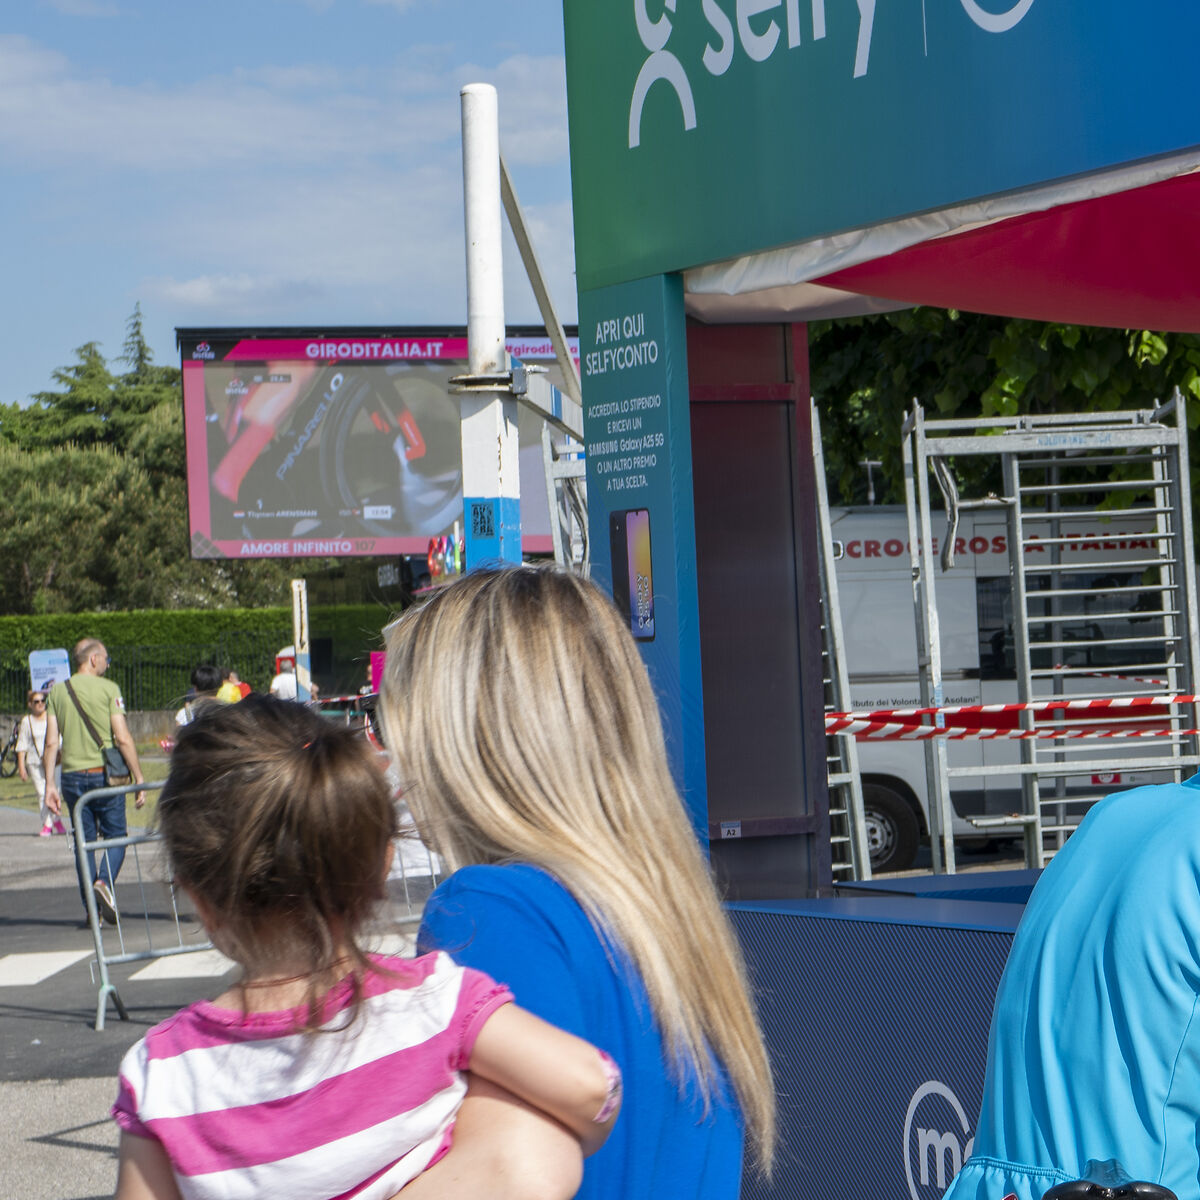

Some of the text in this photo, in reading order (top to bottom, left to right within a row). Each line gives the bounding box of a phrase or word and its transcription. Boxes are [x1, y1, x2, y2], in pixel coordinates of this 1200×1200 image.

[595, 313, 645, 345] APRI QUI
[306, 342, 443, 358] GIRODITALIA.IT
[586, 340, 658, 376] SELFYCONTO
[588, 394, 661, 419] ACCREDITA LO STIPENDIO
[607, 417, 642, 434] E RICEVI UN
[588, 432, 664, 456] SAMSUNG Galaxy A25 5G
[597, 454, 657, 474] O UN ALTRO PREMIO
[607, 474, 648, 491] A TUA SCELTA.
[240, 539, 376, 555] AMORE INFINITO 107
